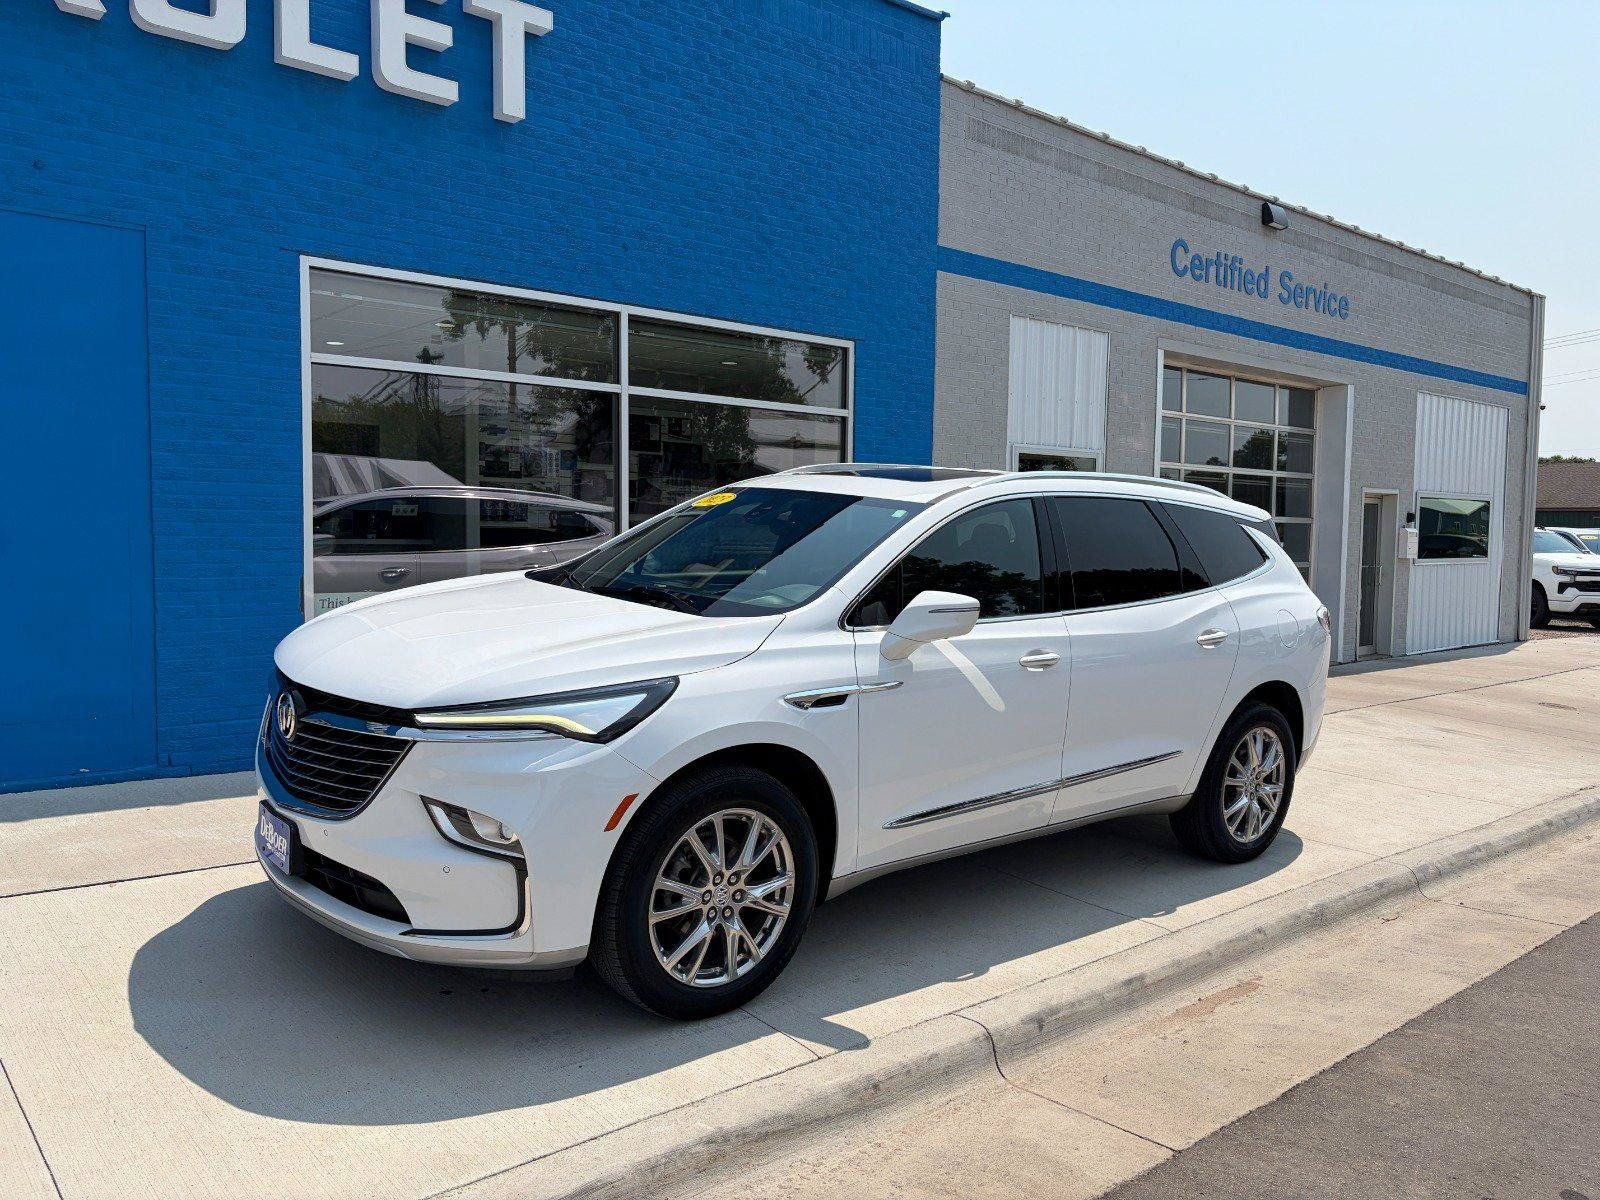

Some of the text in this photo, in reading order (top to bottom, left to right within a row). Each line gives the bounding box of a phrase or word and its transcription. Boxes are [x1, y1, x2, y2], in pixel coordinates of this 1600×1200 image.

[1171, 238, 1349, 319] Certified Service
[319, 597, 343, 609] This
